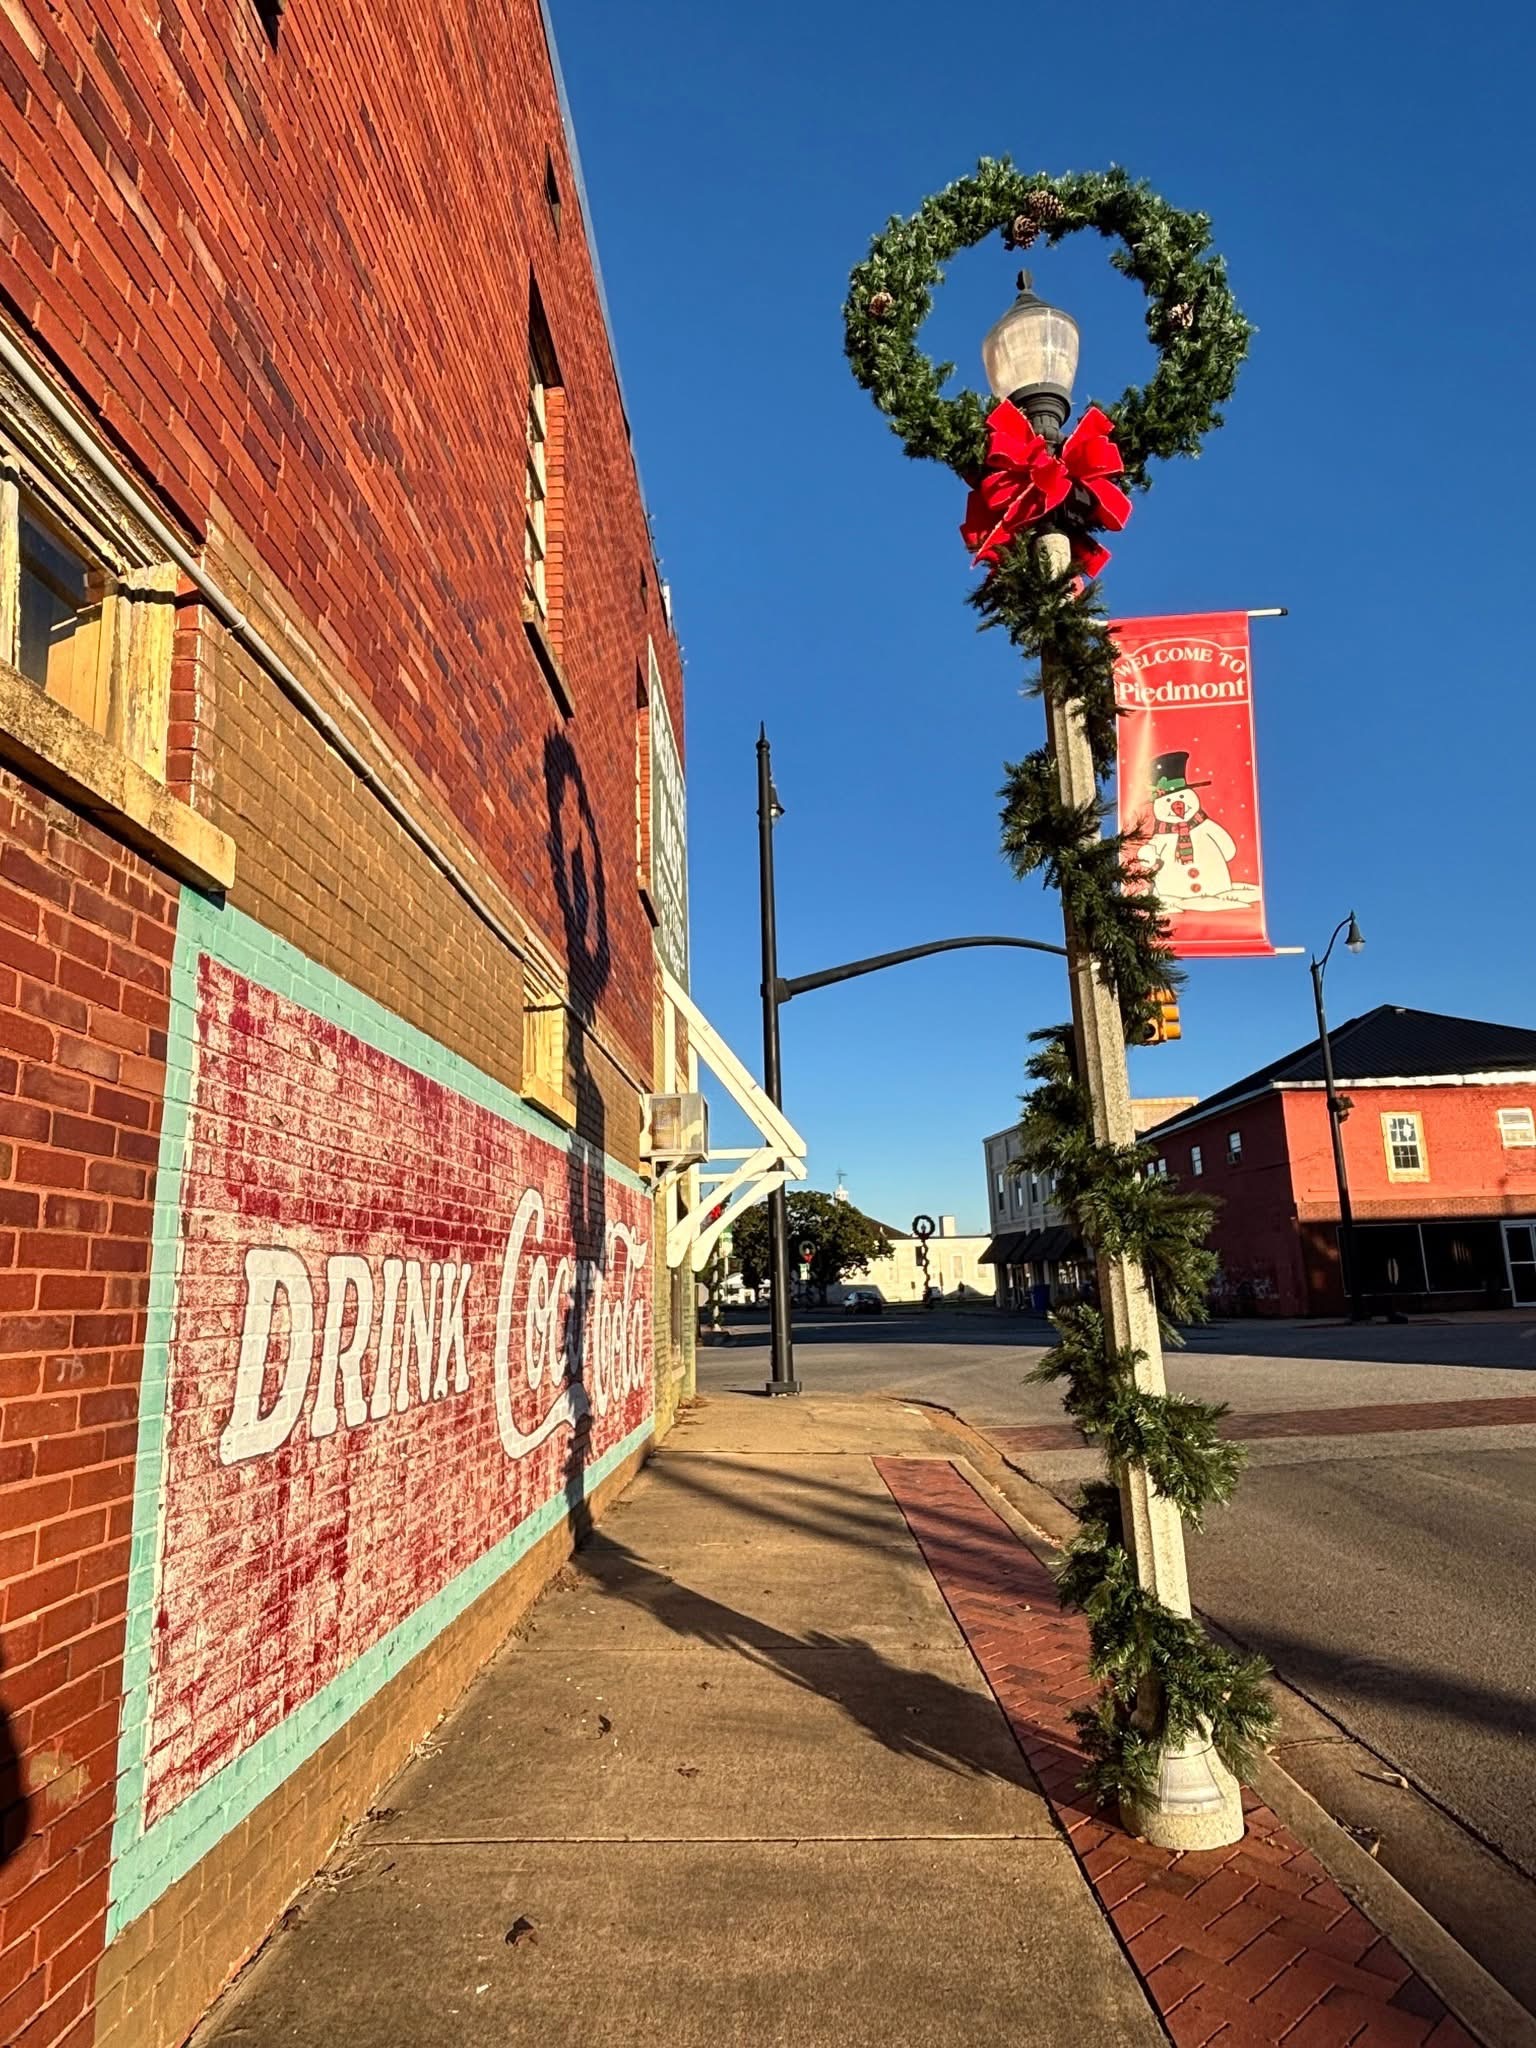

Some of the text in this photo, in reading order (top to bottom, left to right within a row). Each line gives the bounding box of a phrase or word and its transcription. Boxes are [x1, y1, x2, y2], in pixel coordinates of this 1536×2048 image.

[1115, 647, 1246, 677] WELCOME TO
[1119, 677, 1246, 703] Piedmont
[219, 1247, 473, 1466] DRINK
